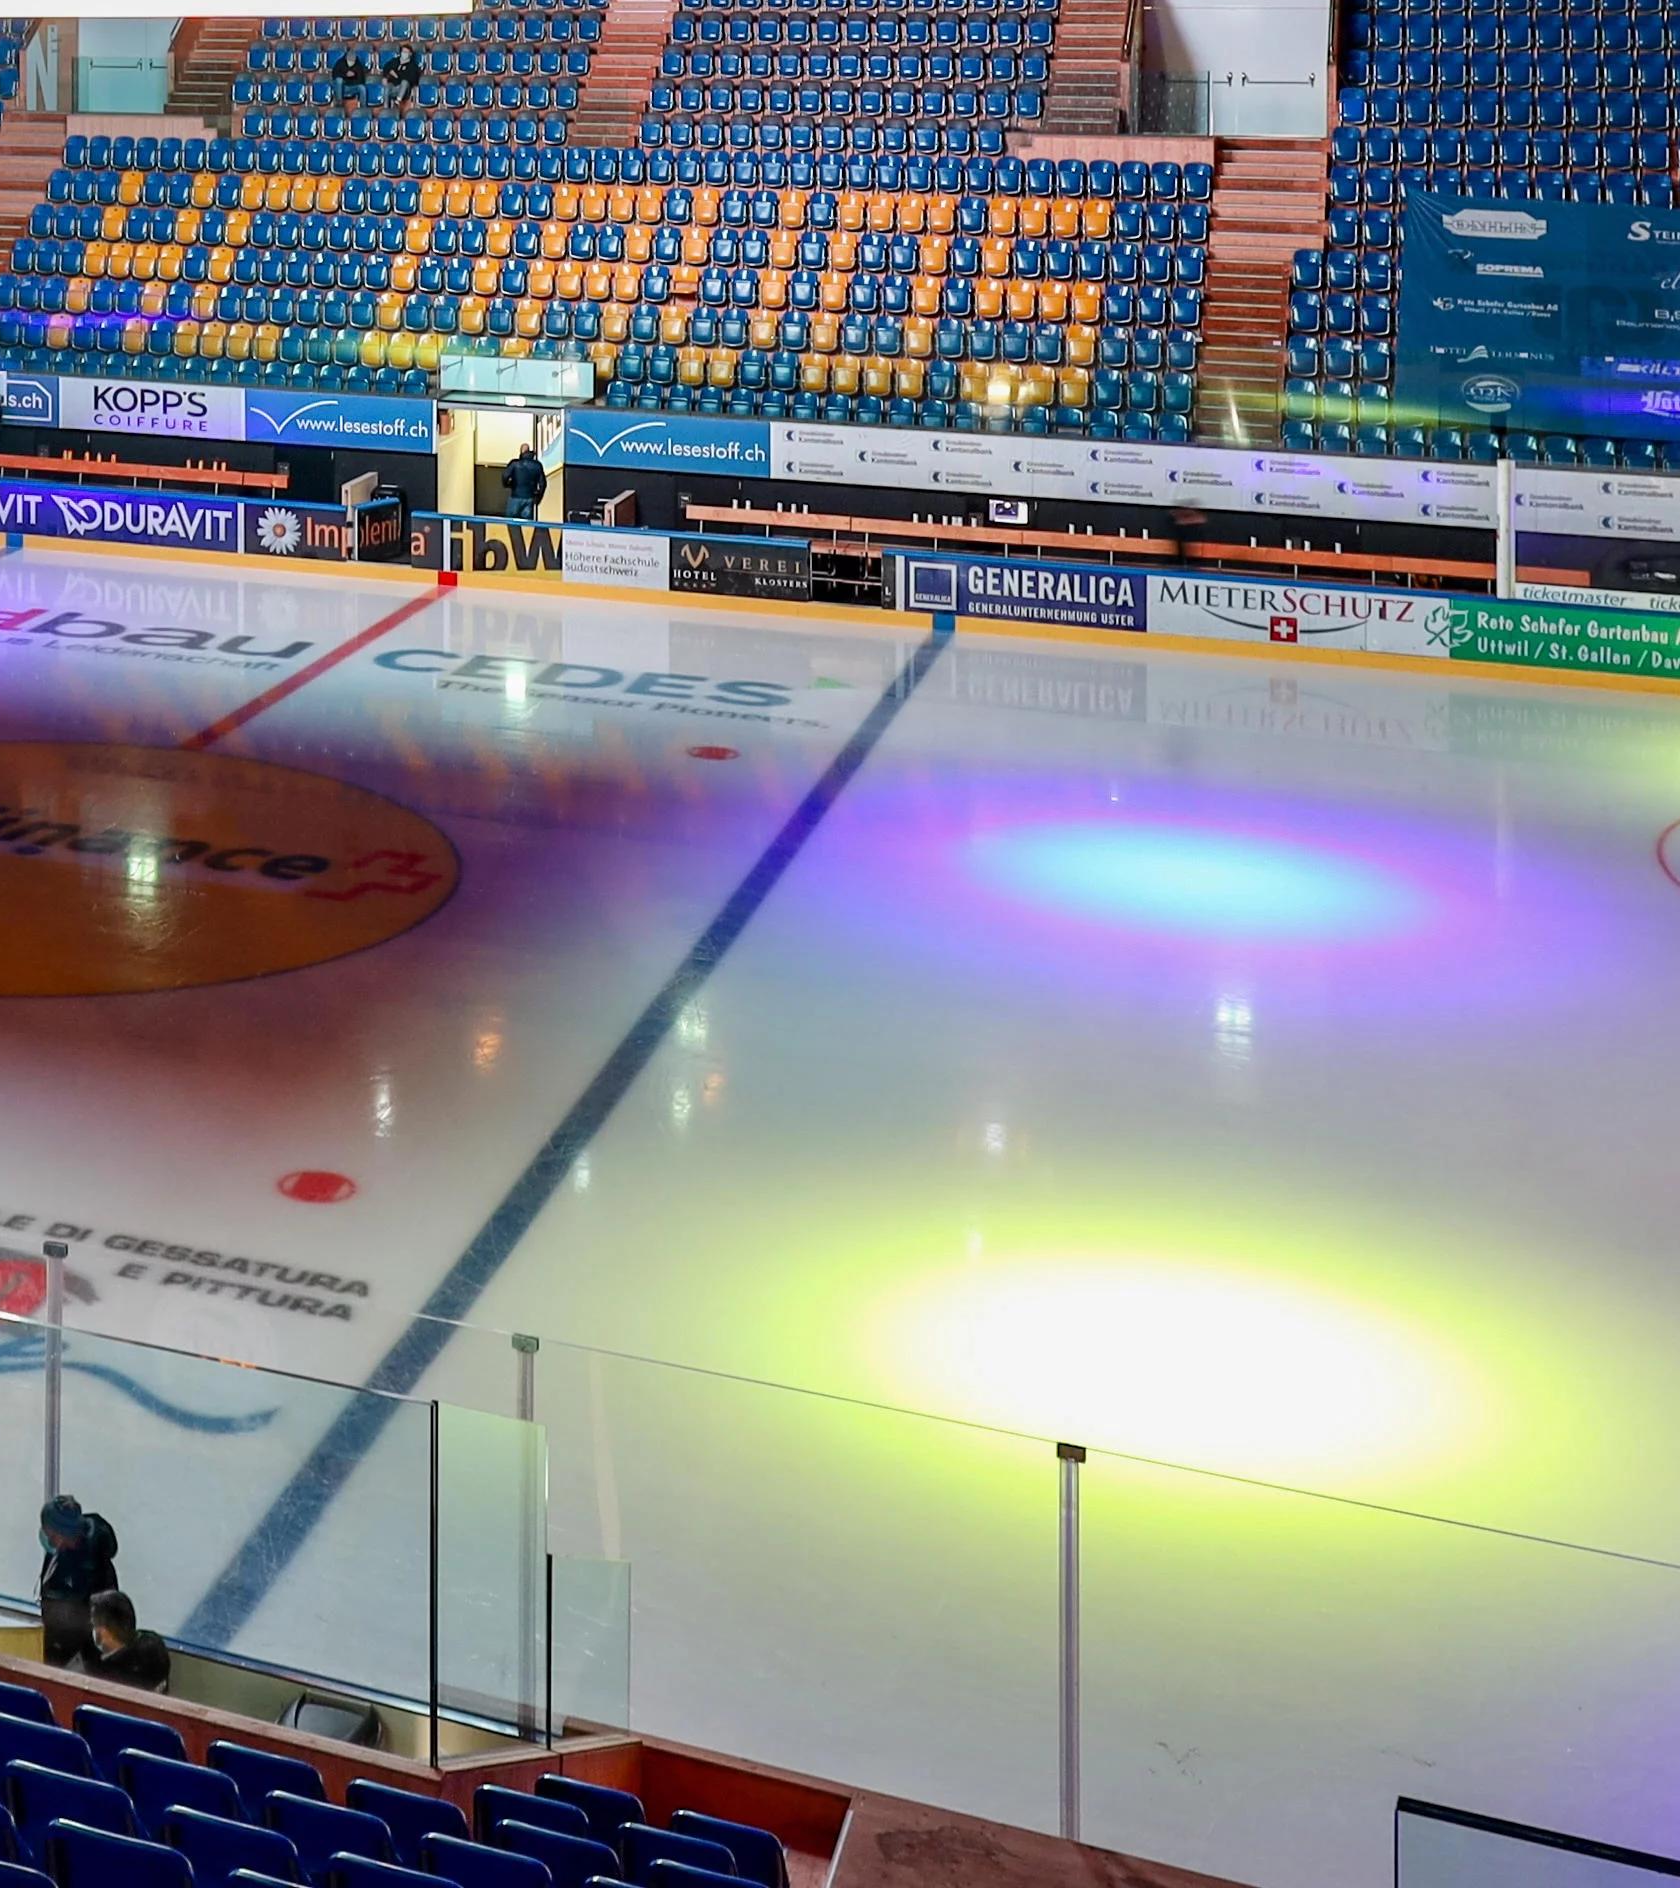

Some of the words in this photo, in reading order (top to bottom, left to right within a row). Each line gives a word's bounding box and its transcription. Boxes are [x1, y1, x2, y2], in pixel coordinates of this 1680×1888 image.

[1476, 263, 1543, 275] SOPREMA
[93, 386, 208, 416] KOPP'S
[93, 413, 208, 432] COIFFURE
[295, 416, 428, 438] www.lesestoff.ch
[620, 438, 766, 462] www.lesestoff.ch
[107, 502, 232, 543] DURAVIT
[564, 551, 601, 566] Höhere
[604, 554, 660, 568] Fachschule
[564, 561, 639, 577] Südostschweiz
[673, 569, 717, 581] HOTEL
[754, 576, 808, 588] KLOSTERS
[967, 566, 1135, 607] GENERALICA
[915, 593, 952, 603] GENERALICA
[1159, 580, 1415, 623] MIETERSCHUTZ
[1523, 587, 1628, 608] ticketmaster
[968, 602, 1097, 624] GENERALUNTERNEHMUNG
[1100, 614, 1135, 627] USTER
[1478, 612, 1513, 631] Reto
[1520, 617, 1581, 637] Schefer
[1587, 623, 1670, 644] Gartenbau
[1478, 637, 1529, 657] Uttwil
[1549, 643, 1574, 661] St.
[1578, 645, 1632, 665] Gallen
[372, 647, 793, 709] CEDES
[46, 1222, 94, 1244] DI
[102, 1233, 373, 1299] GESSATURA
[116, 1264, 143, 1281] E
[155, 1271, 355, 1323] PITTURA
